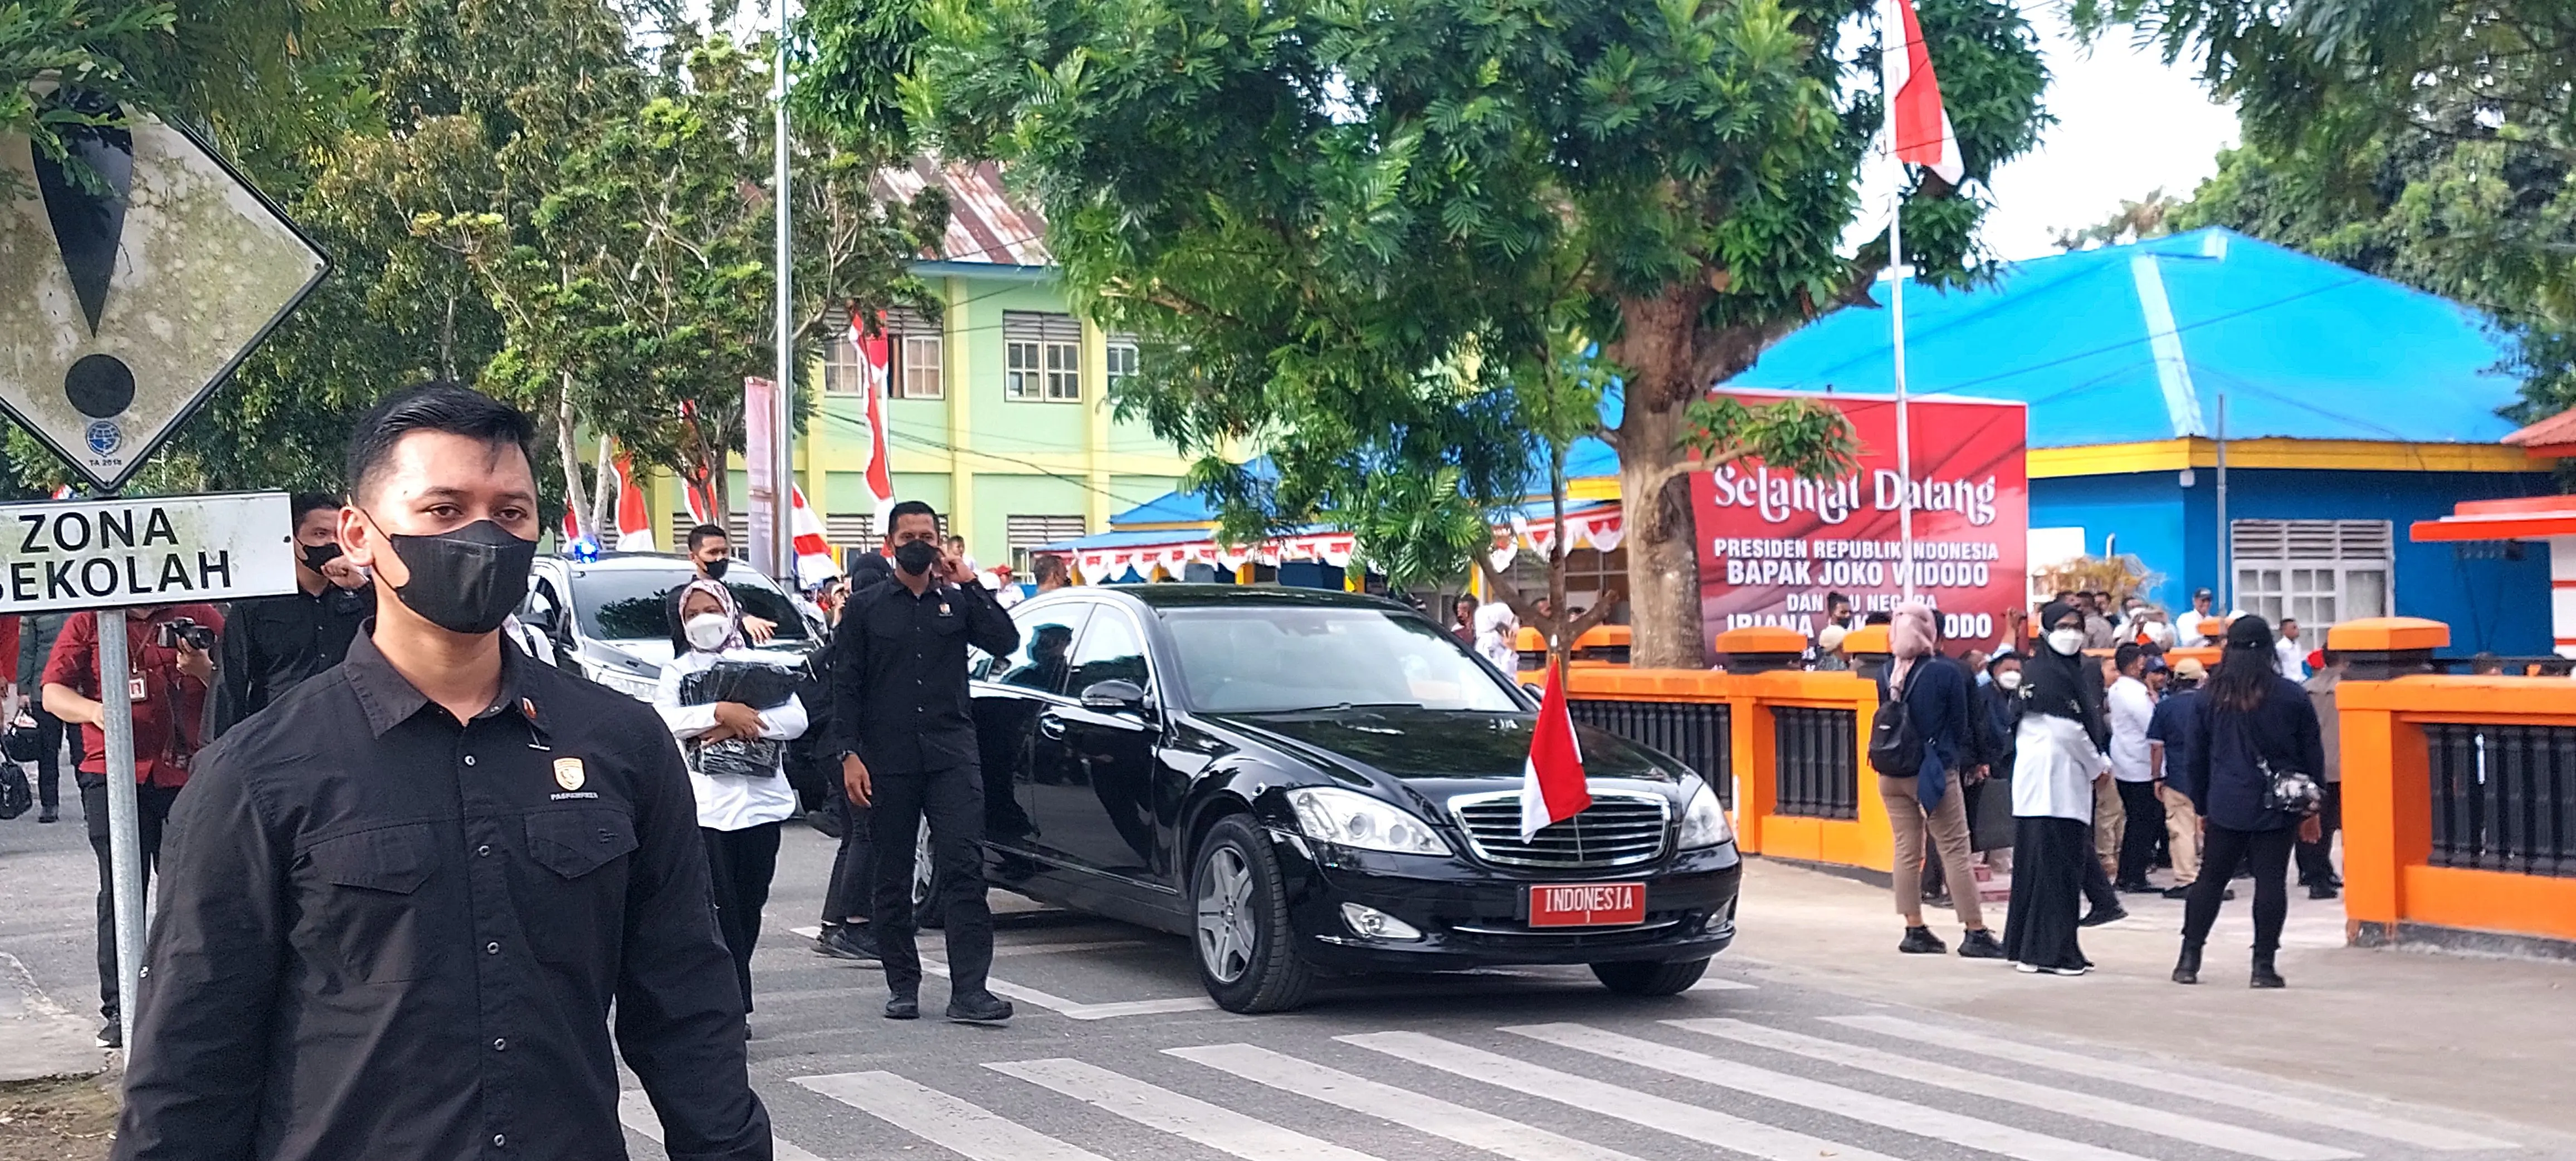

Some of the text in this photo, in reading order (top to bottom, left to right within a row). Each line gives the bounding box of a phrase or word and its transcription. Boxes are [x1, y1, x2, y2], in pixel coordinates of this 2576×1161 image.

[1714, 465, 1860, 524] Selamat
[18, 508, 179, 553] ZONA
[1714, 538, 1999, 560] PRESIDEN REPUBLIK NDONESIA
[0, 550, 232, 601] EKOLAH
[1727, 559, 1988, 587] BAPAK JOKO WIDODO
[1787, 593, 1823, 612] DAN
[1545, 887, 1632, 912] INDONESIA
